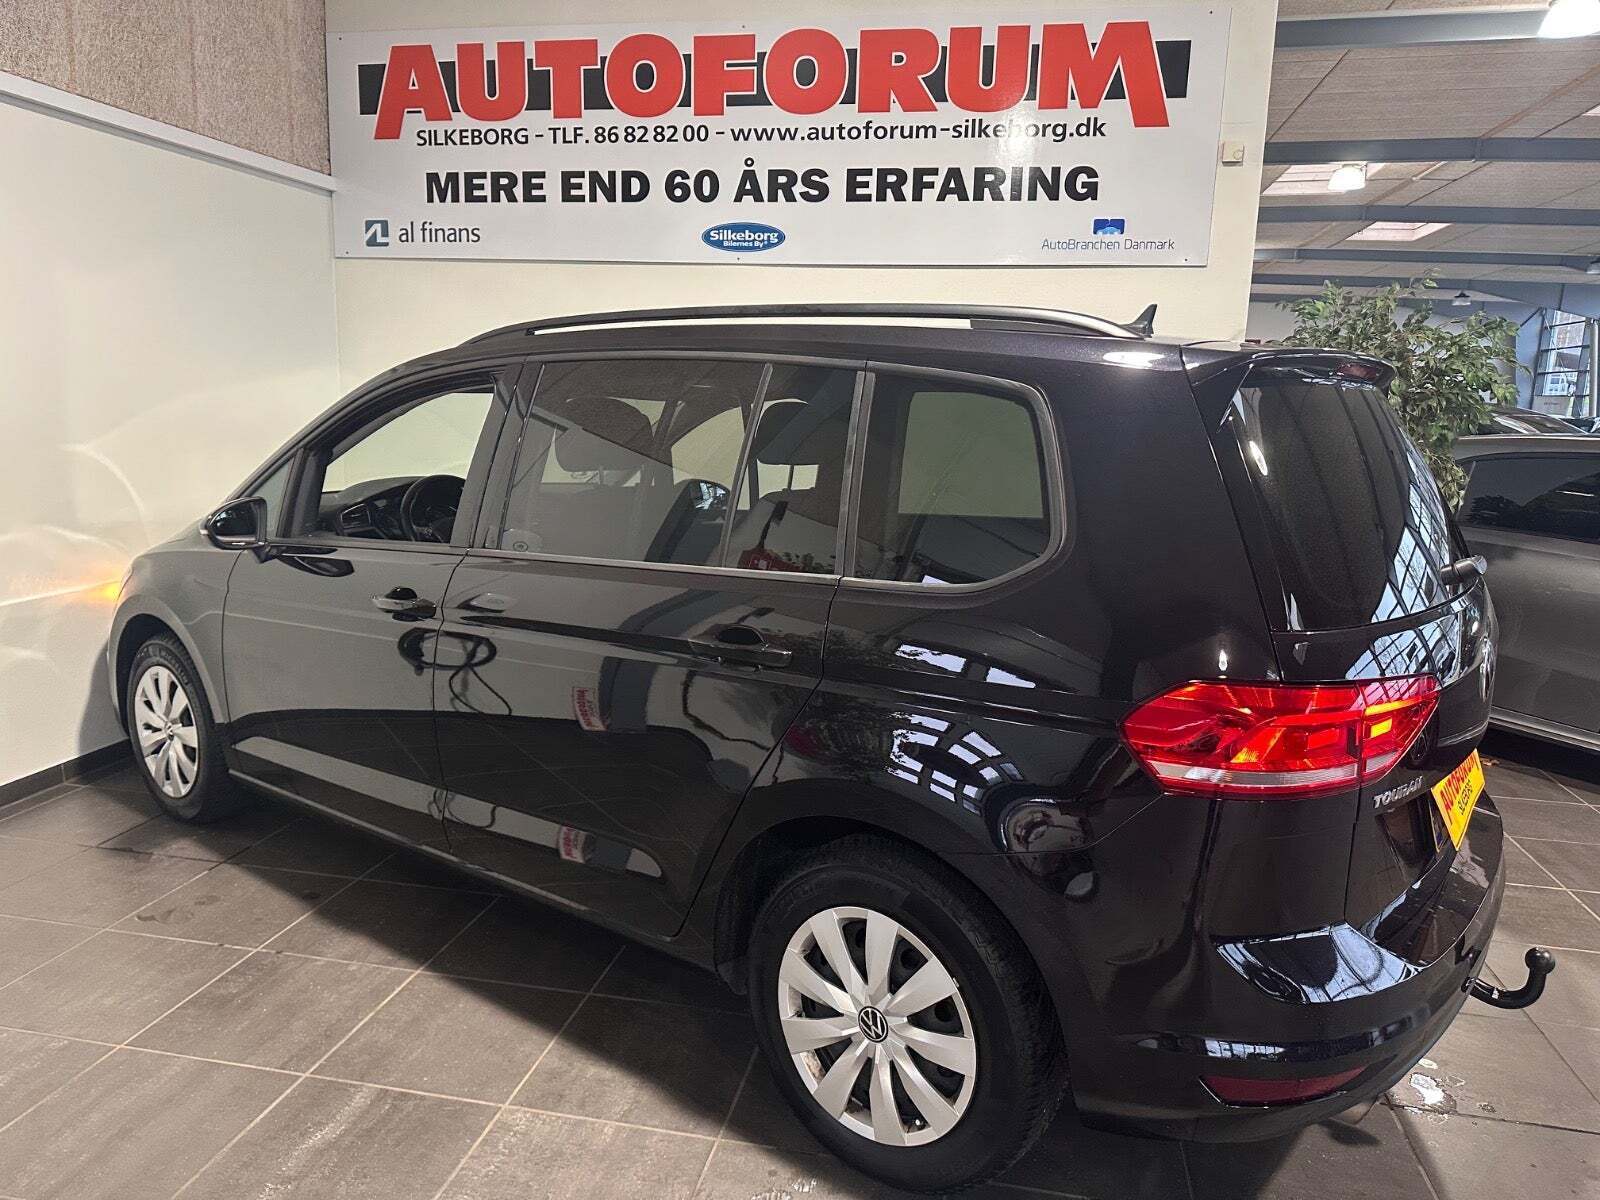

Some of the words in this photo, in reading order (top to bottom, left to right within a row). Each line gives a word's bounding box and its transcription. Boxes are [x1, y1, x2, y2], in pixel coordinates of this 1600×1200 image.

[375, 22, 1168, 139] AUTOFORUM
[417, 128, 528, 146] SILKEBORG
[548, 127, 589, 144] TLF.
[594, 126, 619, 143] 86
[624, 126, 648, 143] 82
[653, 125, 678, 142] 82
[683, 125, 708, 142] 00
[426, 171, 546, 203] MERE
[561, 171, 650, 202] END
[665, 170, 719, 203] 60
[734, 157, 829, 202] ÅRS
[846, 166, 1098, 202] ERFARING
[399, 221, 414, 242] al
[421, 221, 480, 242] finans
[710, 230, 778, 243] Silkeborg
[1041, 239, 1120, 251] AutoBranchen
[1124, 239, 1175, 250] Danmark
[1373, 775, 1423, 809] TOURAN
